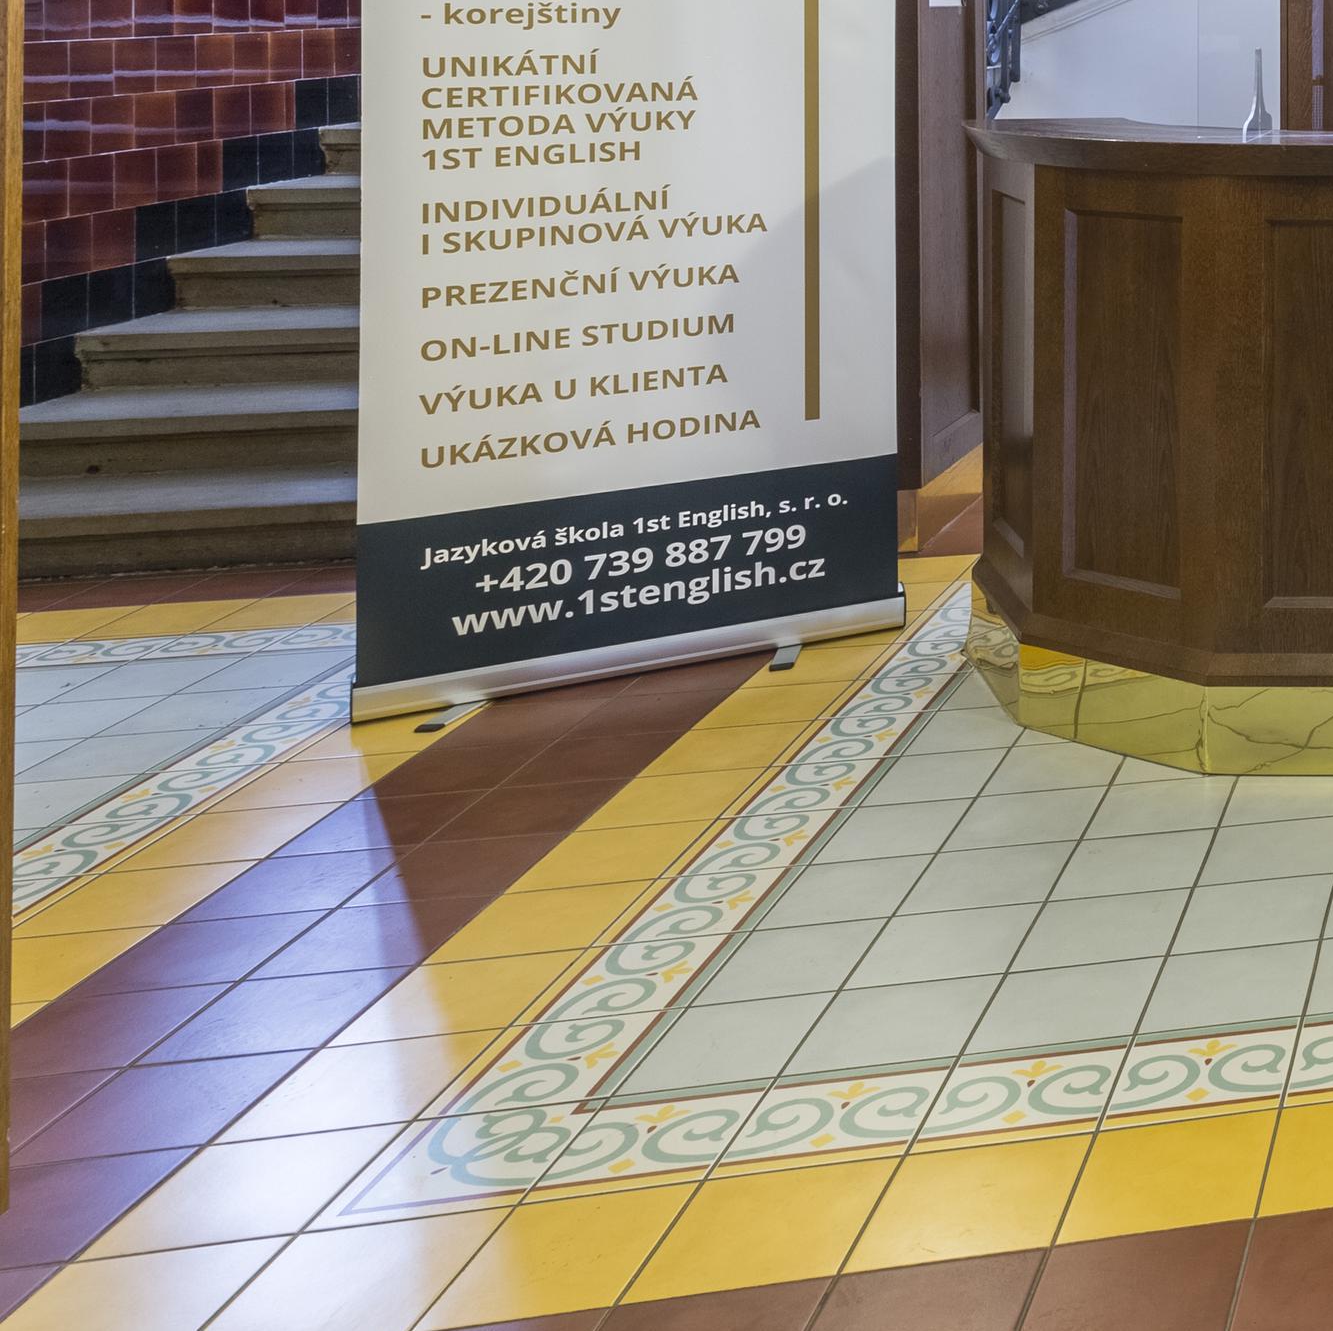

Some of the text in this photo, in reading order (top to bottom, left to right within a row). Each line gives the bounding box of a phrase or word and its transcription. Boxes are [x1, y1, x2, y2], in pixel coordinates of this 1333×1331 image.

[443, 2, 622, 30] korejštiny
[421, 48, 599, 79] UNIKÁTNÍ
[421, 76, 699, 110] CERTIFIKOVANÁ
[421, 107, 697, 141] METODA VÝUKY
[421, 140, 642, 171] 1ST ENGLISH
[421, 184, 670, 224] INDIVIDUÁLNÍ
[420, 212, 768, 255] I SKUPINOVÁ VÝUKA
[421, 263, 740, 309] PREZENČNÍ VÝUKA
[420, 313, 736, 362] ON-LINE STUDIUM
[419, 363, 729, 415] VÝUKA U KLIENTA
[420, 409, 762, 468] UKÁZKOVÁ HODINA
[420, 493, 849, 571] Jazyková škola 1st English, s. r. o.
[475, 524, 807, 594] +420 739 887 799
[451, 557, 826, 636] www.1stenglish.cz
